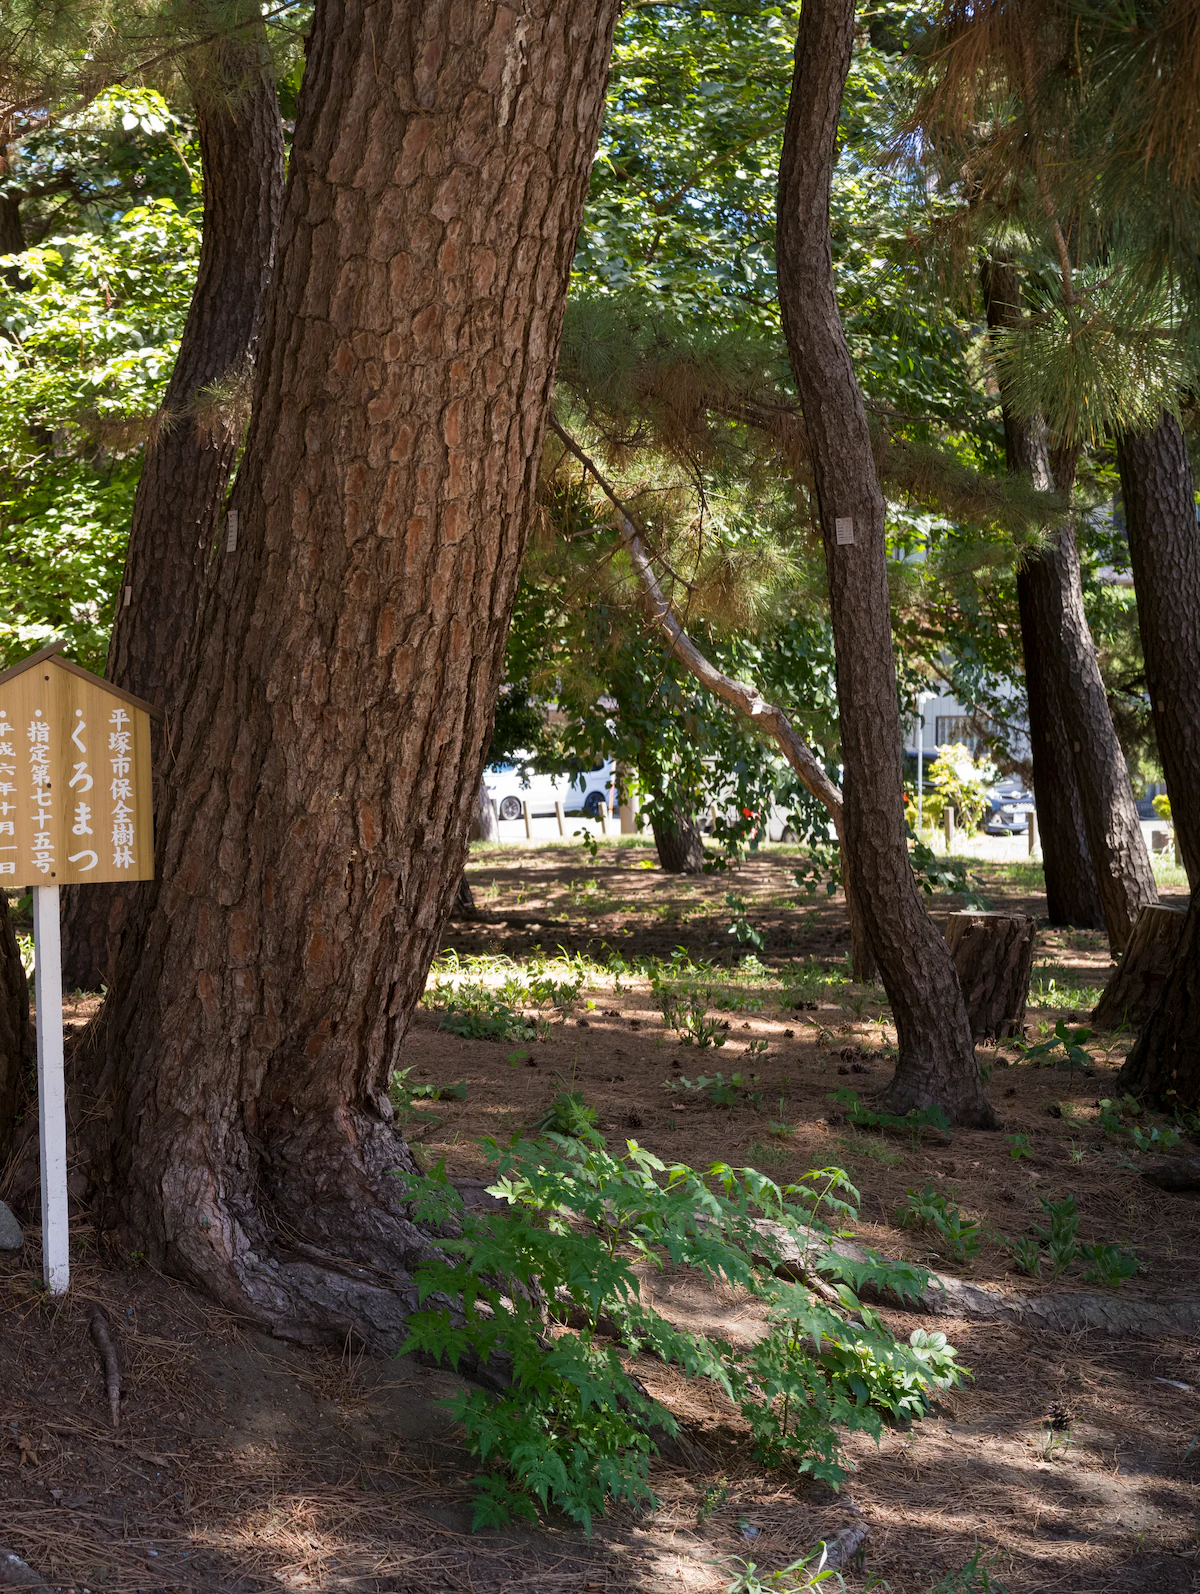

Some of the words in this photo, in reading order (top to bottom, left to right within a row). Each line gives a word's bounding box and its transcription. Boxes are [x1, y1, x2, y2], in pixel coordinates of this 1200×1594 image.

[26, 720, 56, 874] 指定第七十五号
[67, 720, 99, 872] くろまつ
[108, 708, 136, 869] 平塚市保全樹林
